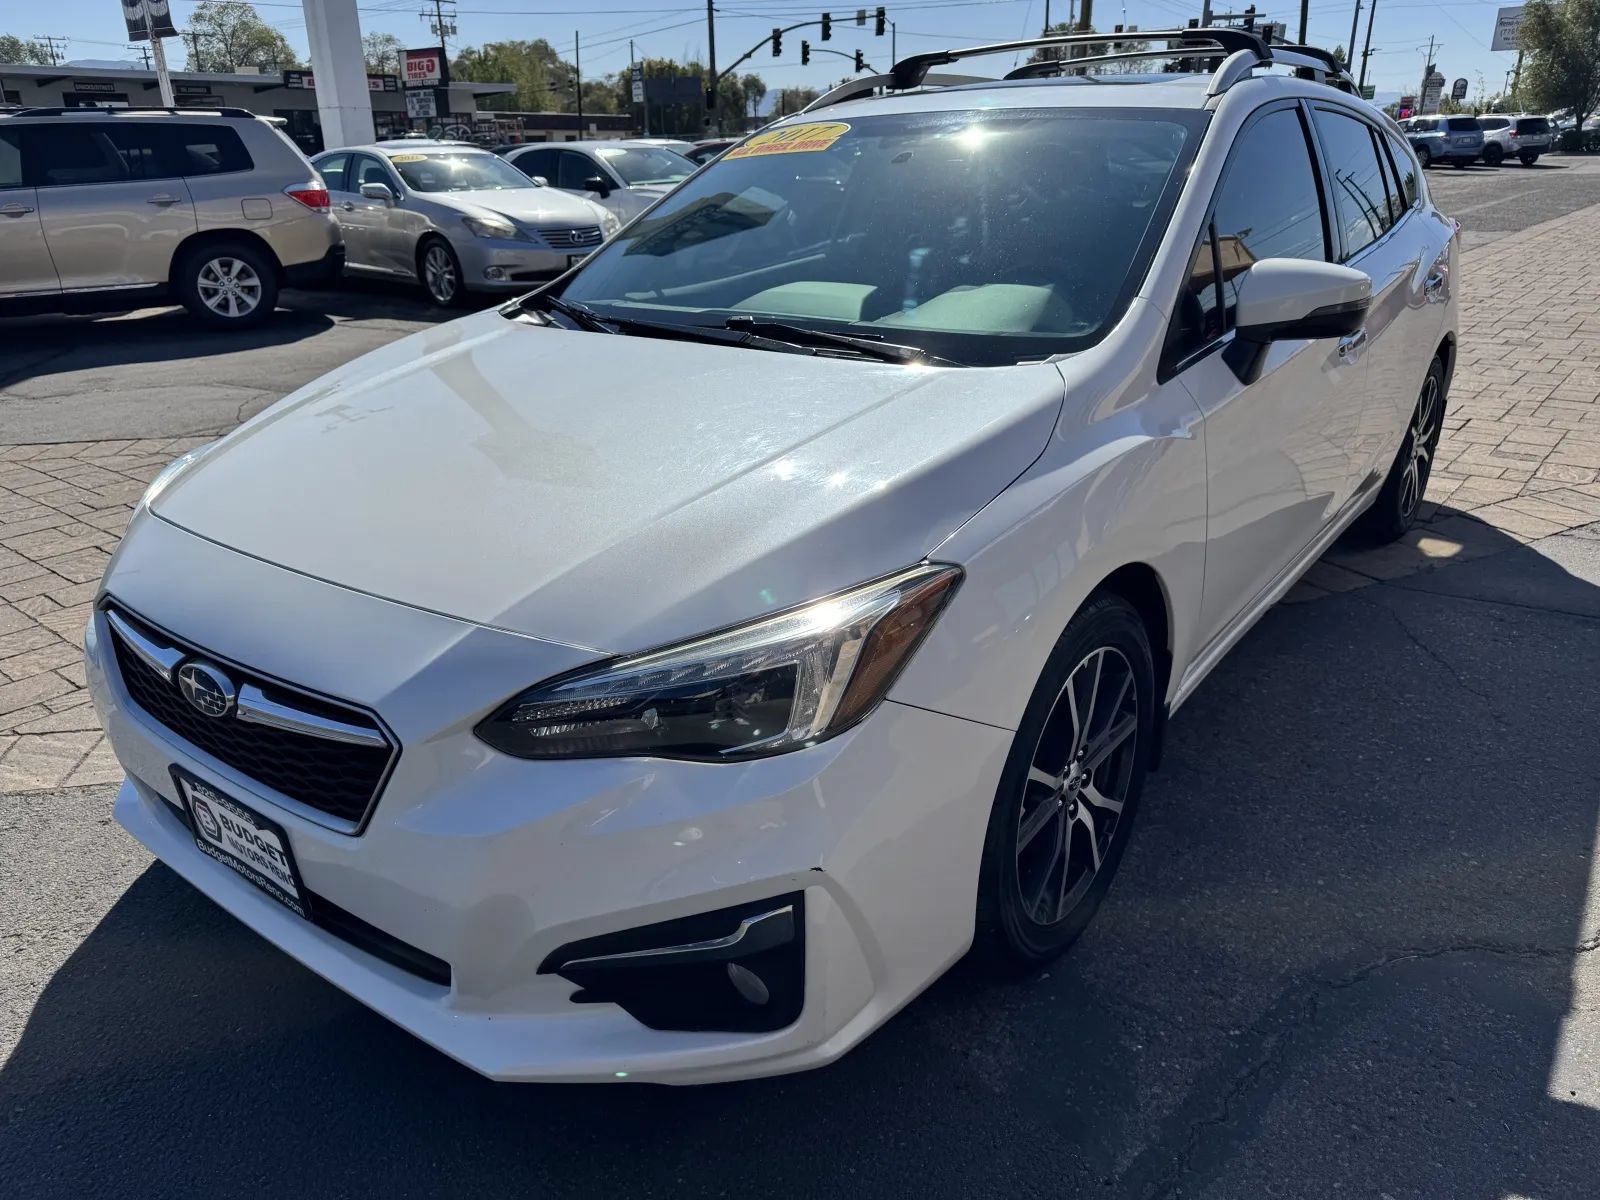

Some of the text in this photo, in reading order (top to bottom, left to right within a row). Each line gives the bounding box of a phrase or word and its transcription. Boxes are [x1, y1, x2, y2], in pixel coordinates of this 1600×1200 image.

[407, 60, 424, 71] BIG
[407, 71, 427, 79] TIRES
[218, 812, 287, 867] BUDGET
[226, 834, 270, 869] MOTORS
[196, 838, 306, 918] BudgetMotorsReno.com
